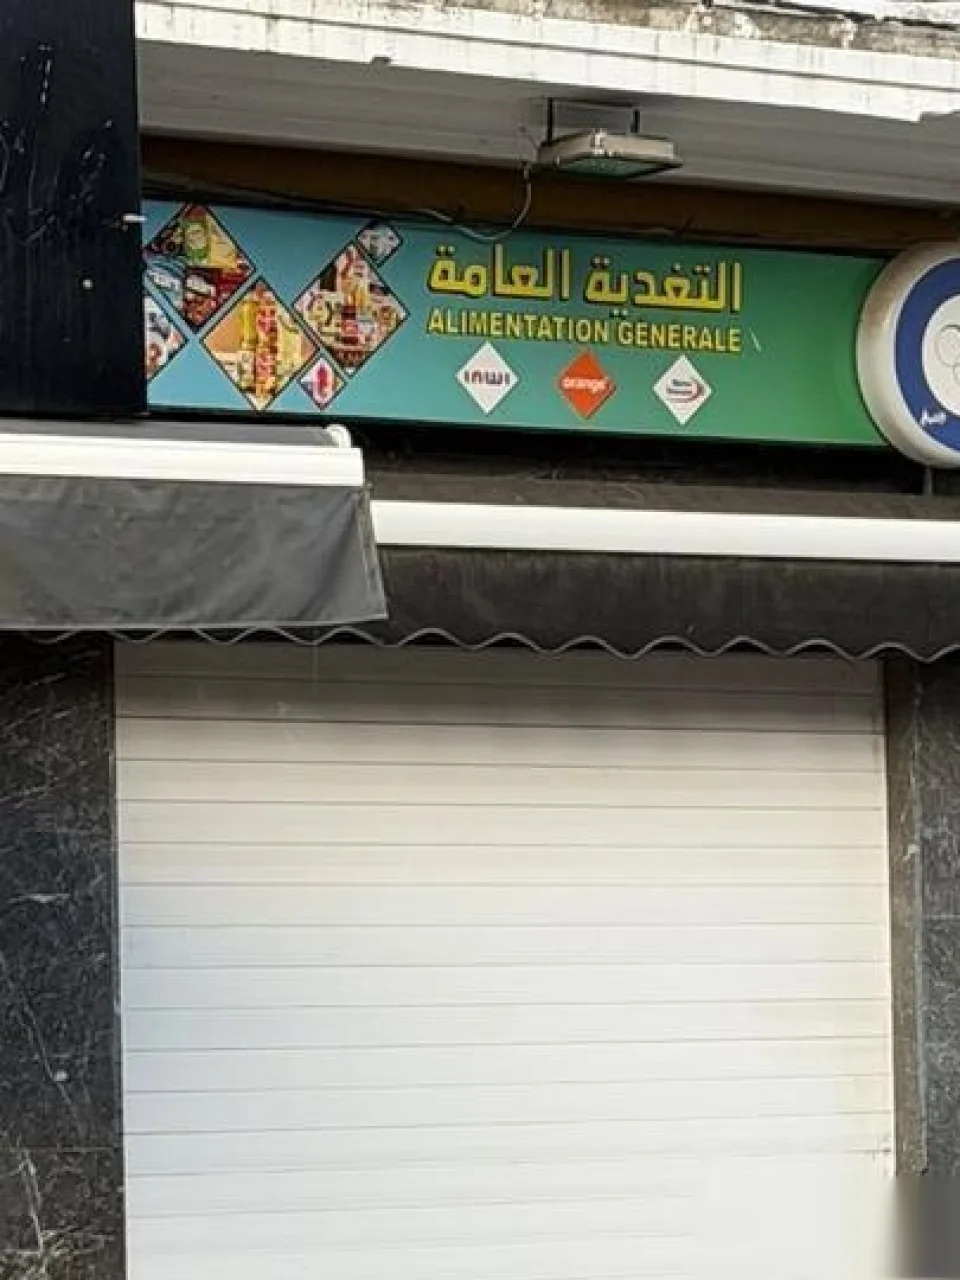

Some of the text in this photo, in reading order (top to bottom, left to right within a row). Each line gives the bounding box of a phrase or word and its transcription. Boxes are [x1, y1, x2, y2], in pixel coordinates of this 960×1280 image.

[430, 243, 570, 299] العامة
[427, 306, 742, 353] ALIMENTATION GENERALE
[561, 376, 609, 394] orange
